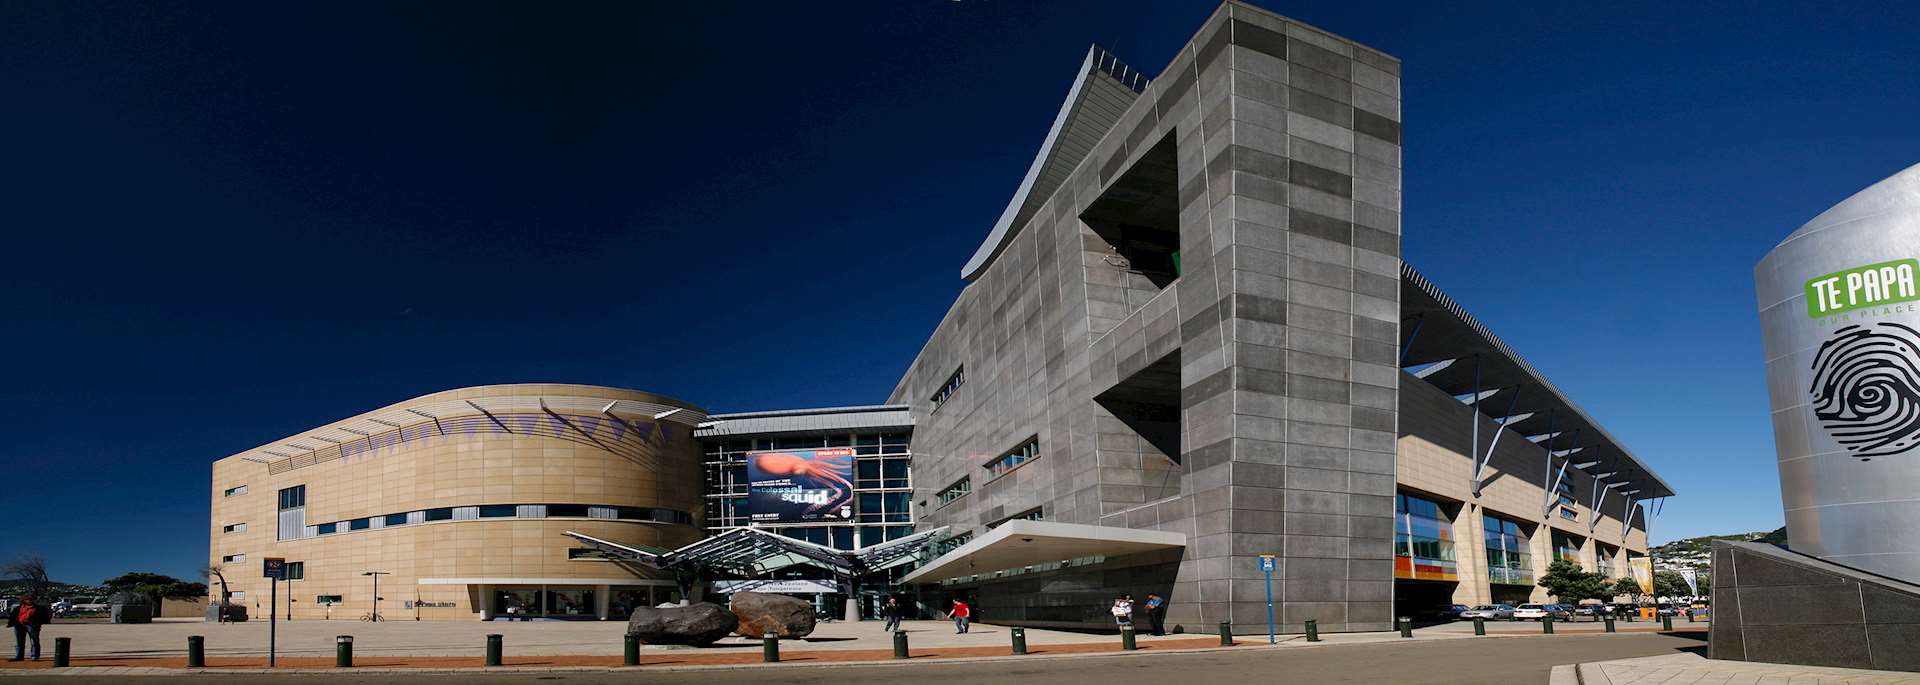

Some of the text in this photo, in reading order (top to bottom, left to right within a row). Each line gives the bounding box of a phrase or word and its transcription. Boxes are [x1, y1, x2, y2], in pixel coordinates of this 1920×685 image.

[1811, 263, 1915, 312] TE PAPA
[1818, 304, 1915, 328] OUR PLACE
[761, 484, 803, 494] Colossal
[781, 489, 828, 505] squid
